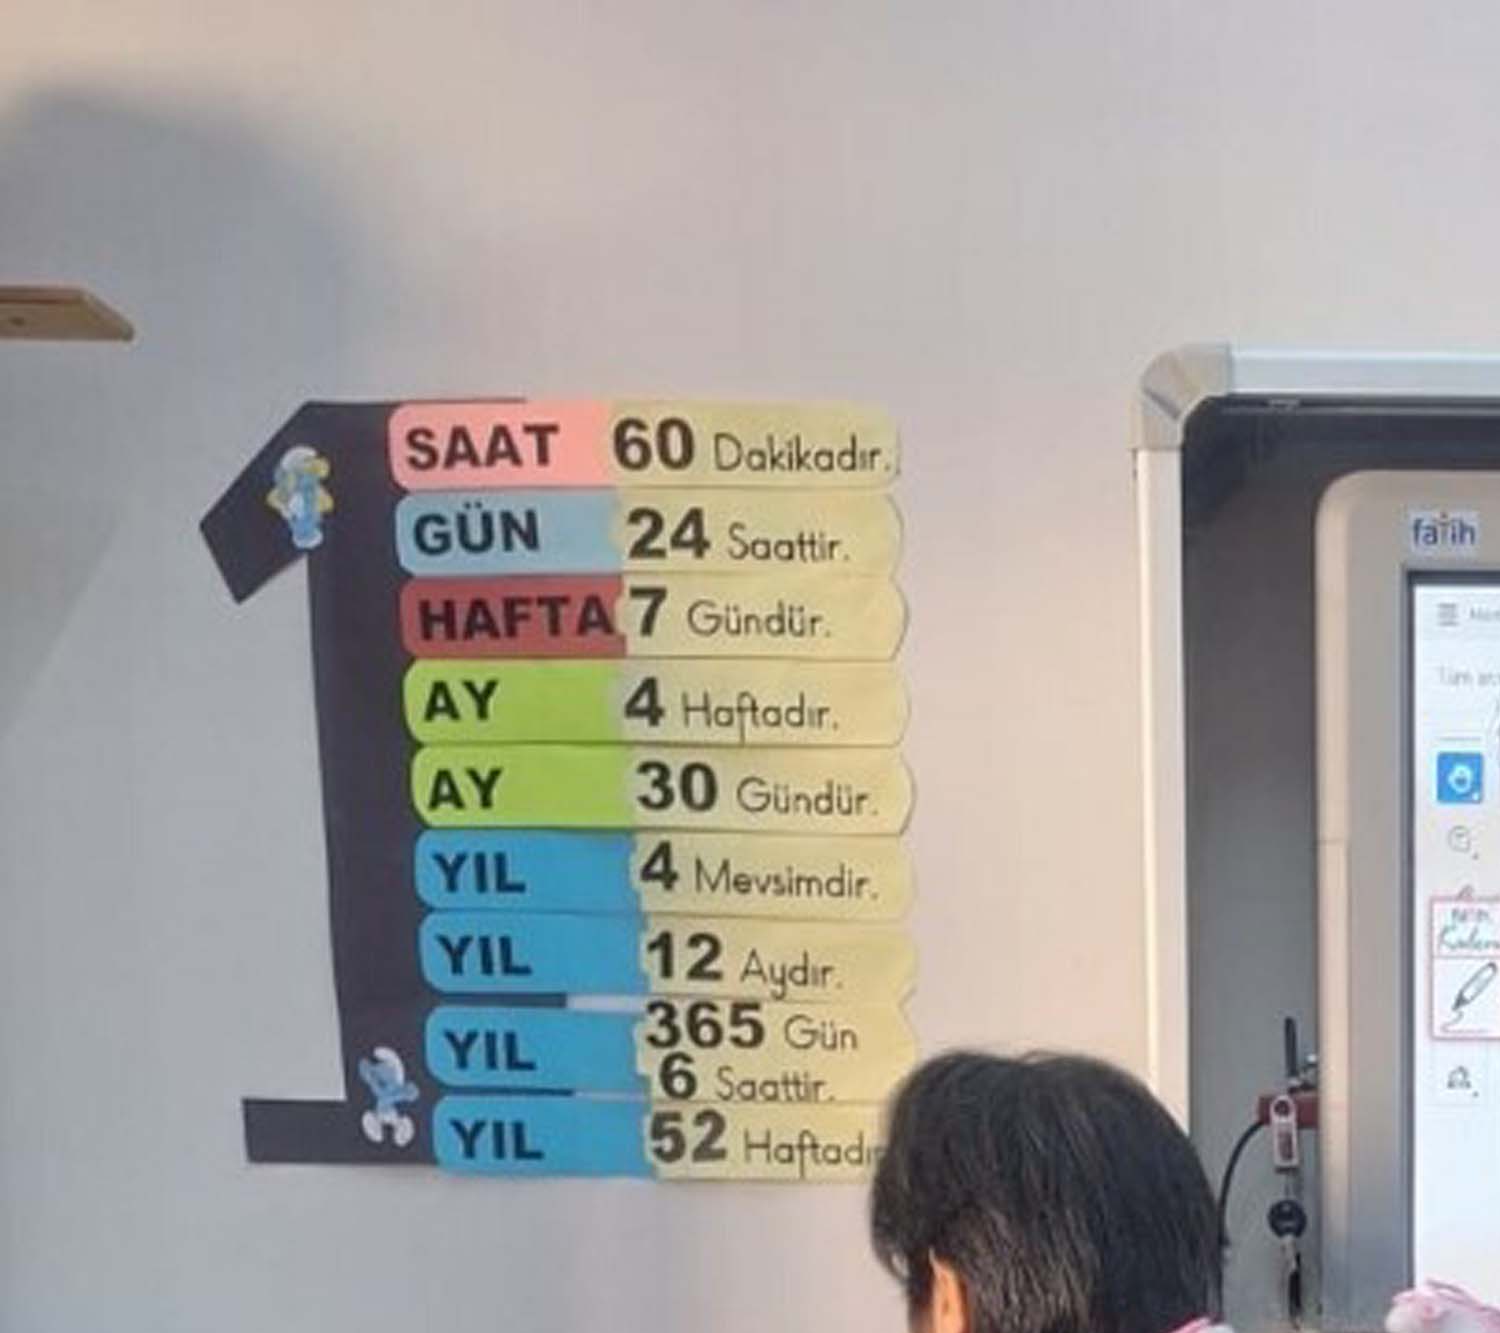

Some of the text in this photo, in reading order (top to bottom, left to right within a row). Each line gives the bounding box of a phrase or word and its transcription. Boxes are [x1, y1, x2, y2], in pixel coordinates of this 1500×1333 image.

[405, 416, 892, 474] SAAT 60 Dakikadır.
[412, 502, 850, 563] GÜN 24 Saattir.
[1413, 513, 1477, 546] fatih
[418, 586, 832, 642] HAFTA 7 Gündür.
[423, 675, 840, 745] AY 4 Haftadır.
[428, 760, 880, 817] AY 30 Gündür.
[432, 840, 880, 900] YIL 4 Mevsimdir.
[437, 930, 844, 1000] YIL 12 Aydır.
[443, 1000, 859, 1073] YIL 365 Gün
[659, 1052, 837, 1103] 6 Saattir.
[450, 1119, 545, 1162] YIL
[649, 1109, 728, 1164] 52
